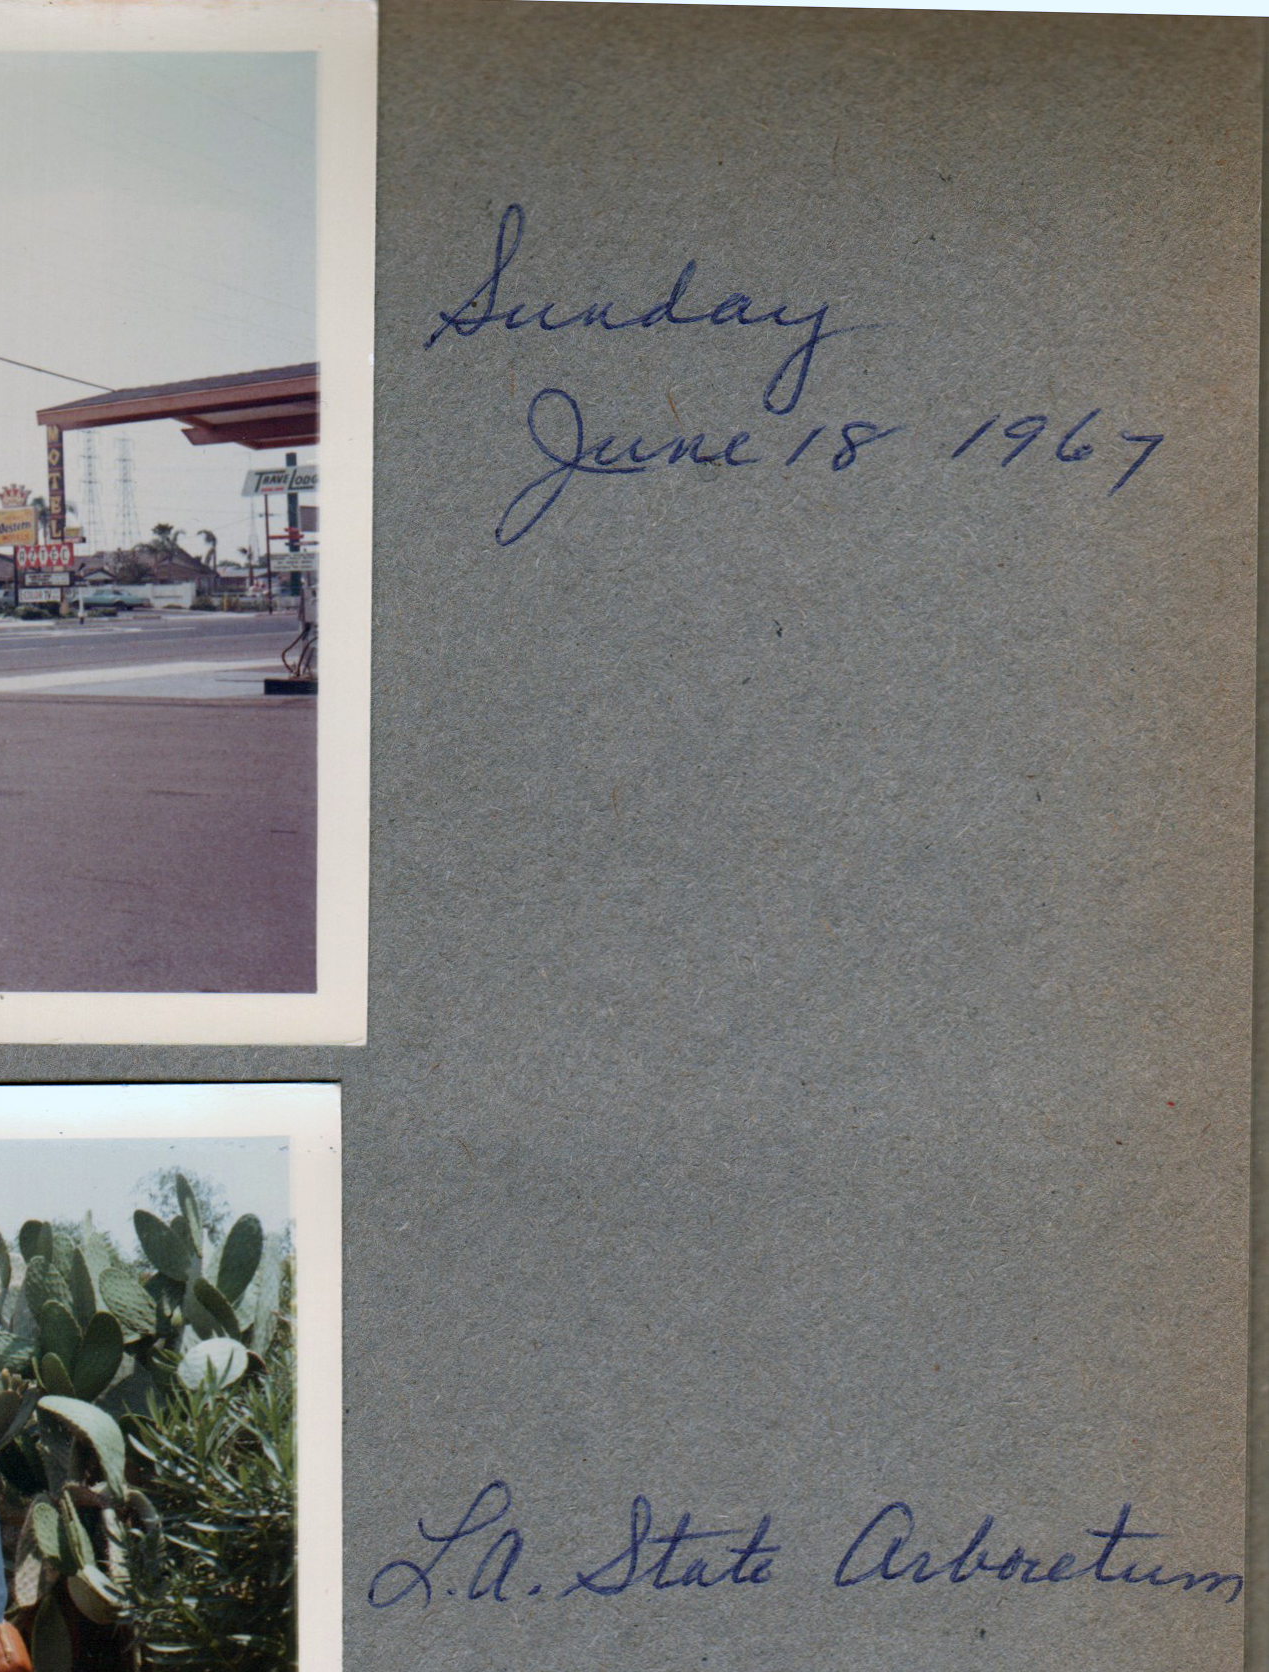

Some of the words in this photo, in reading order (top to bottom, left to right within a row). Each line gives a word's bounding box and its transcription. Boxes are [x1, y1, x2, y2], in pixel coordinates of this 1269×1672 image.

[422, 202, 870, 415] Sunday
[47, 424, 62, 538] MOTEL
[494, 387, 759, 547] June
[786, 418, 900, 472] 18
[952, 408, 1165, 497] 1967
[18, 547, 68, 563] AZTEC
[367, 1480, 543, 1609] L.A.
[556, 1494, 780, 1597] State
[835, 1500, 1244, 1604] Arboretum
